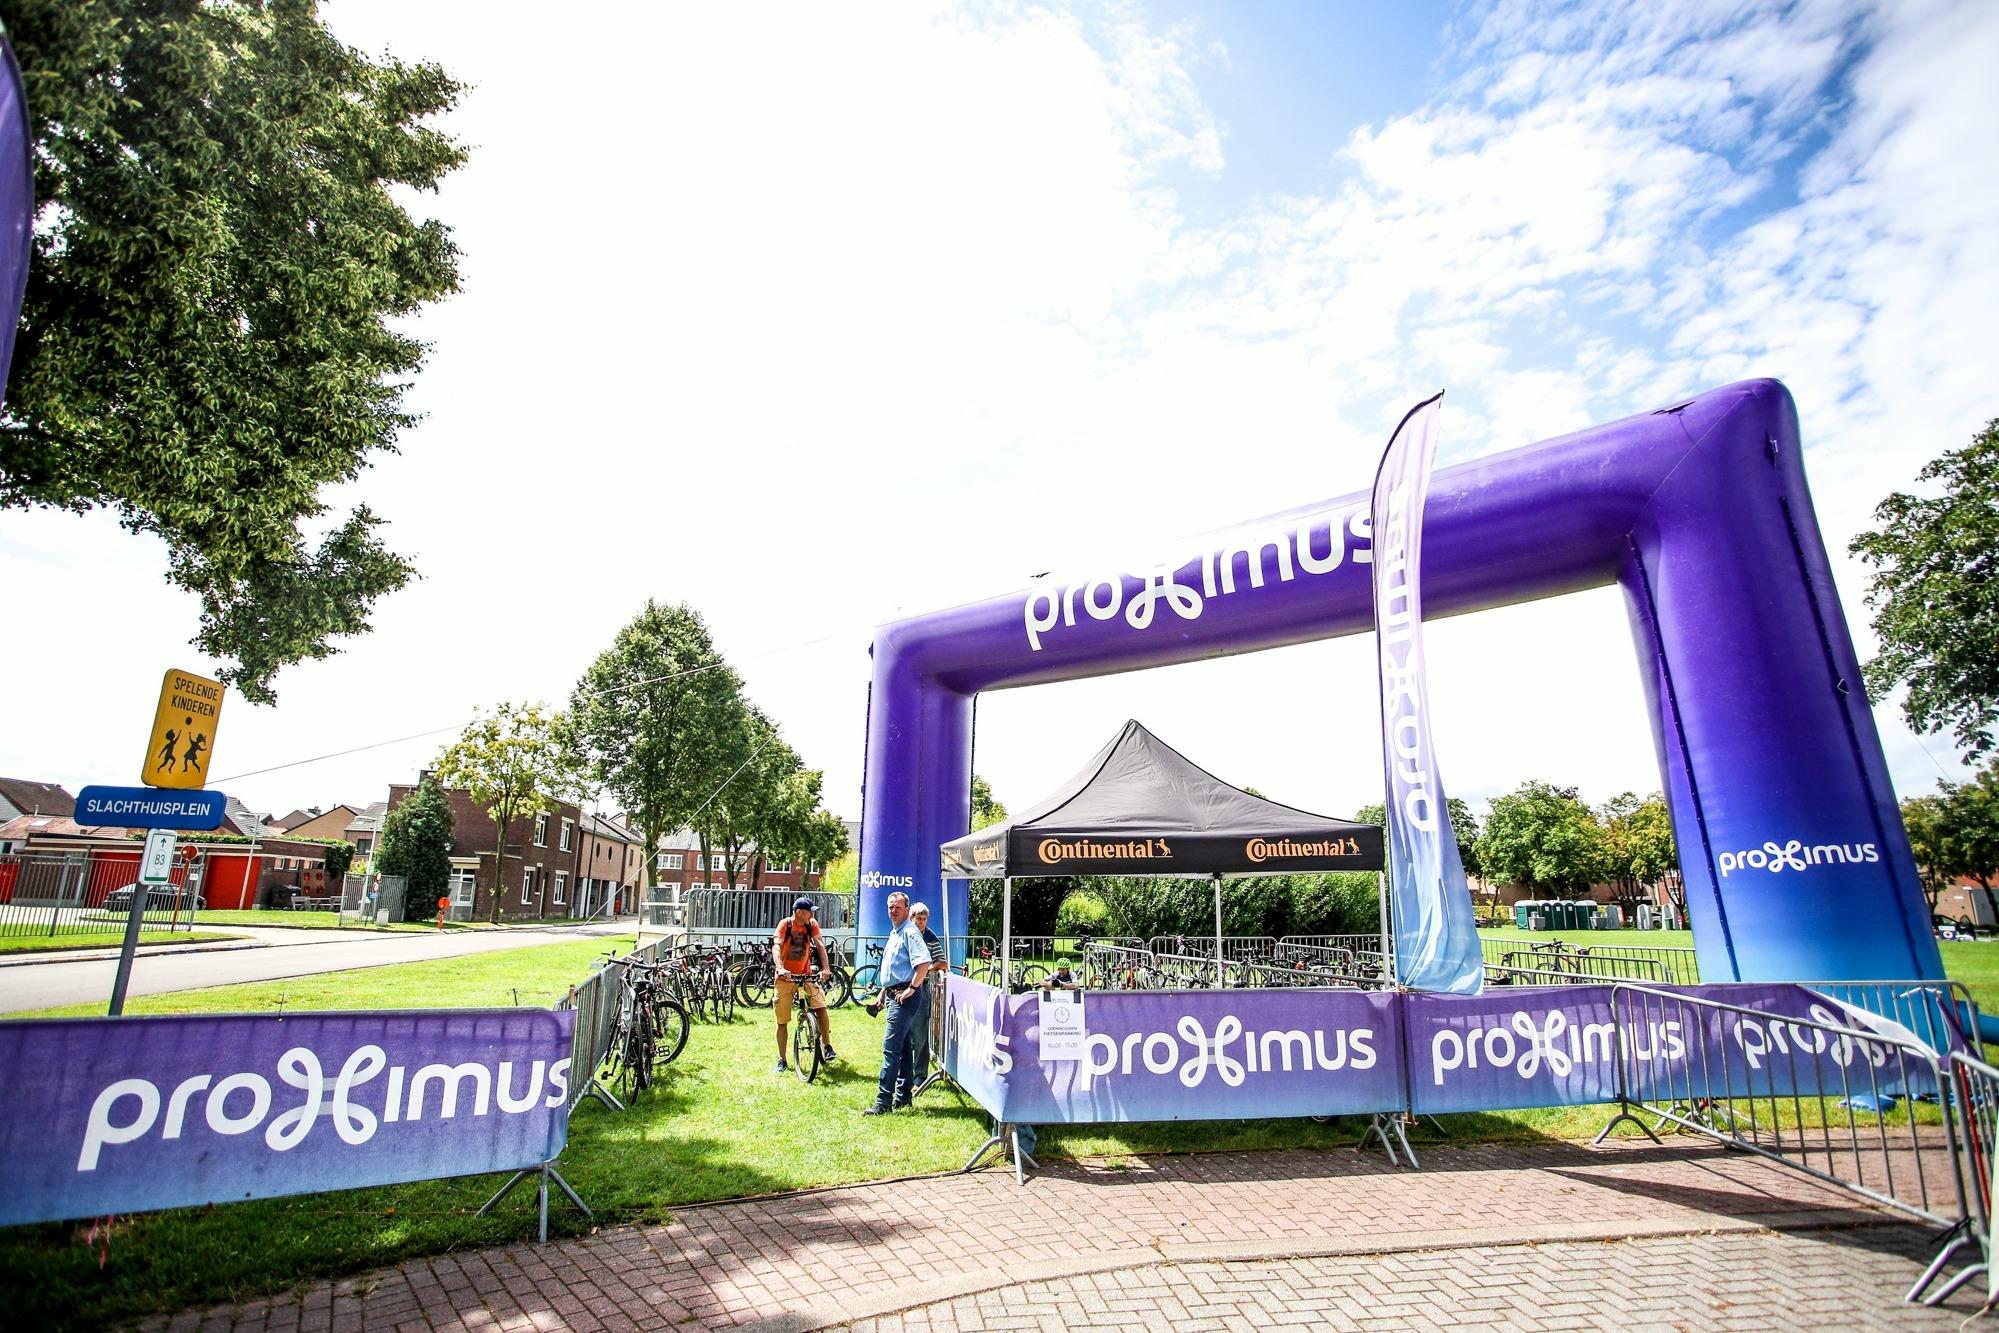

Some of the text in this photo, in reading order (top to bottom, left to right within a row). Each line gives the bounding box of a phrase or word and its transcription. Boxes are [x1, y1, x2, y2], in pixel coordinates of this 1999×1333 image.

[174, 677, 219, 701] SPELENDE
[171, 694, 216, 717] KINDEREN
[87, 799, 211, 816] SLACHTHUISPLEIN
[154, 853, 166, 866] 83
[1038, 838, 1155, 864] Continental
[1245, 836, 1345, 864] Continental
